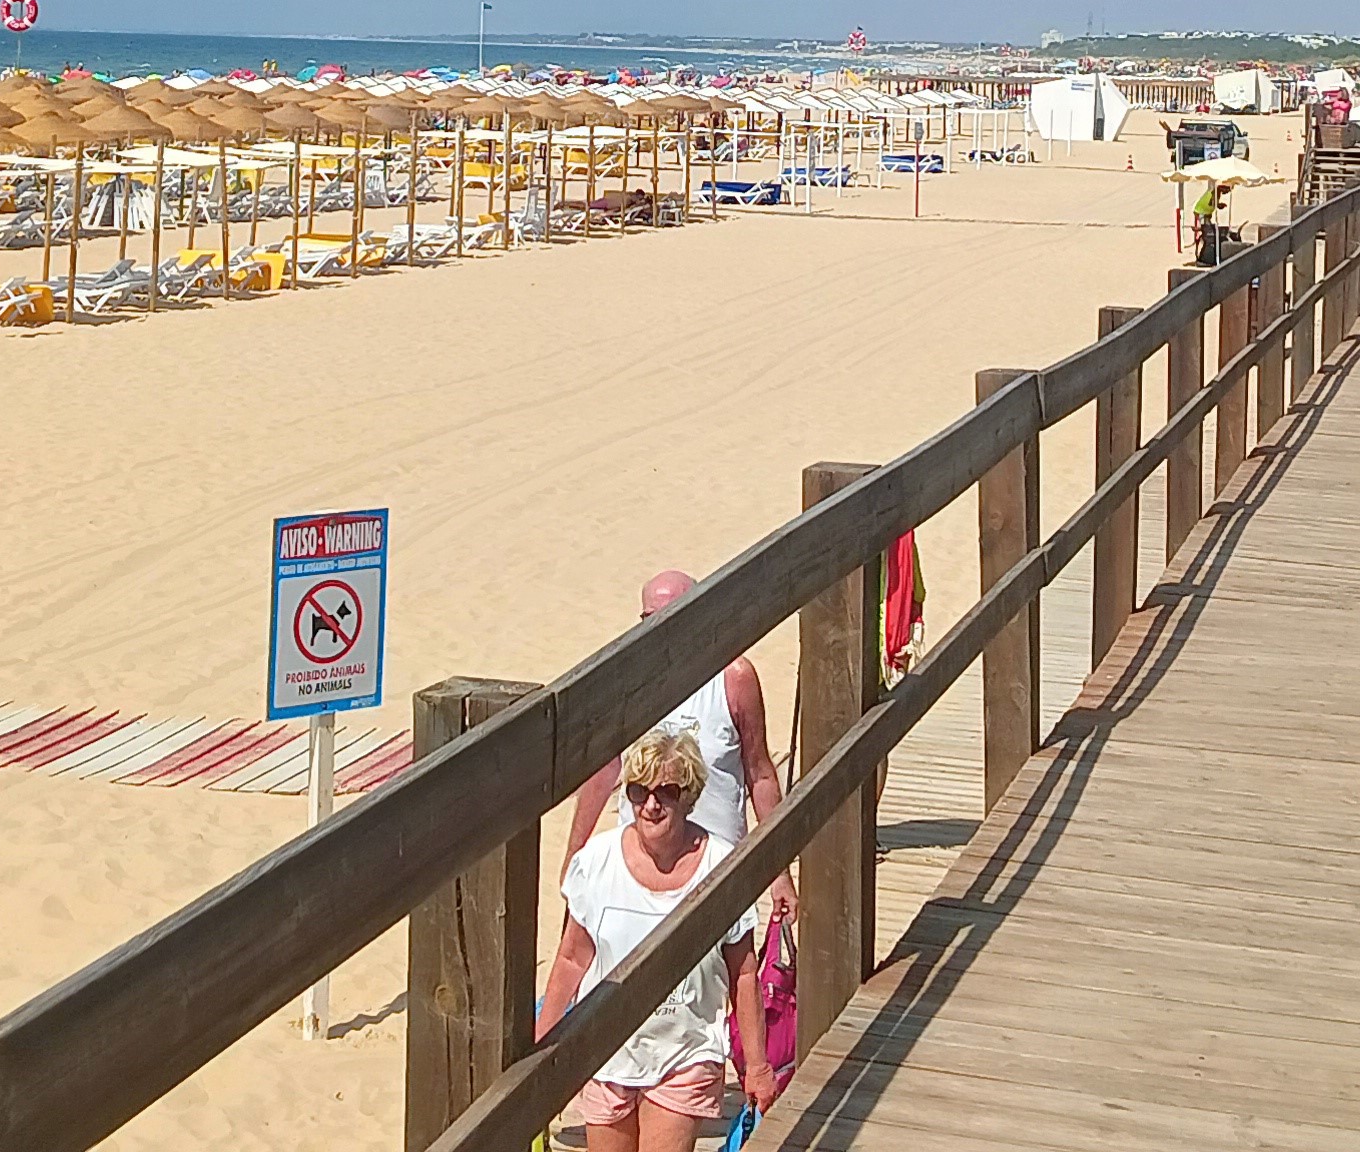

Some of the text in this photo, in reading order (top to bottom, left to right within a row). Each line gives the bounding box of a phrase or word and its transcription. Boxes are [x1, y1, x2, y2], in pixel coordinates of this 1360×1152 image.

[280, 520, 382, 559] AVISO WARNING
[285, 663, 366, 684] PROIBIDO ANIMAIS
[298, 678, 353, 696] NO ANIMALS
